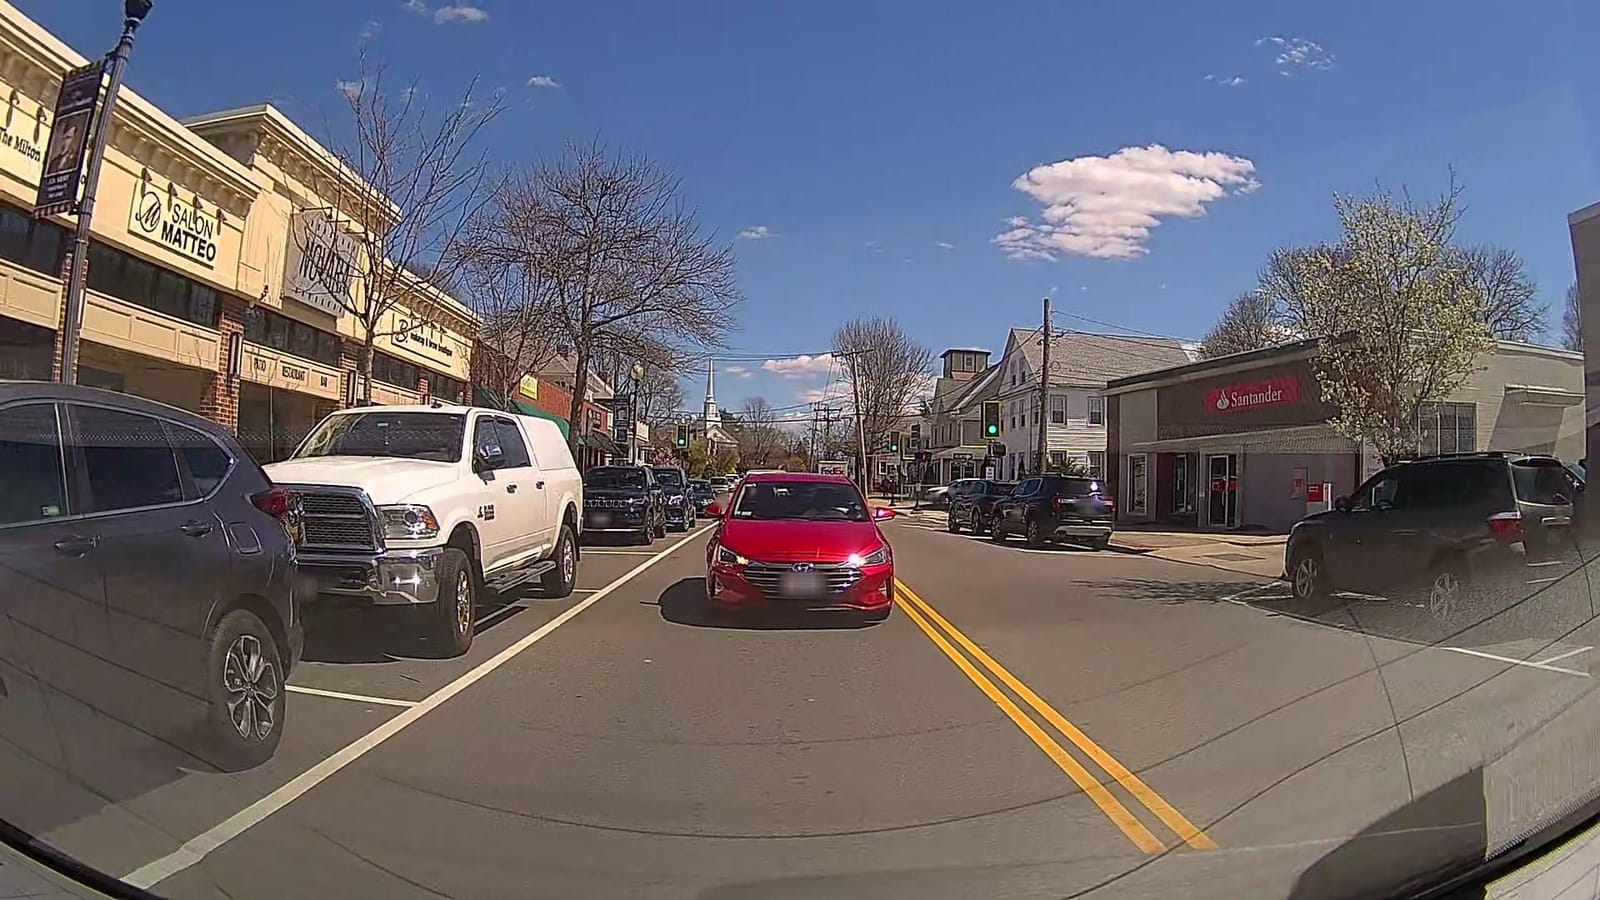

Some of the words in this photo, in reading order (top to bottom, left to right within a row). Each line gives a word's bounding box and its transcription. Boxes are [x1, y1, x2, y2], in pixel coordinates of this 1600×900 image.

[172, 203, 214, 240] SALON
[161, 220, 216, 262] MATTEO
[1231, 385, 1282, 408] Santander
[820, 466, 844, 475] FedEx
